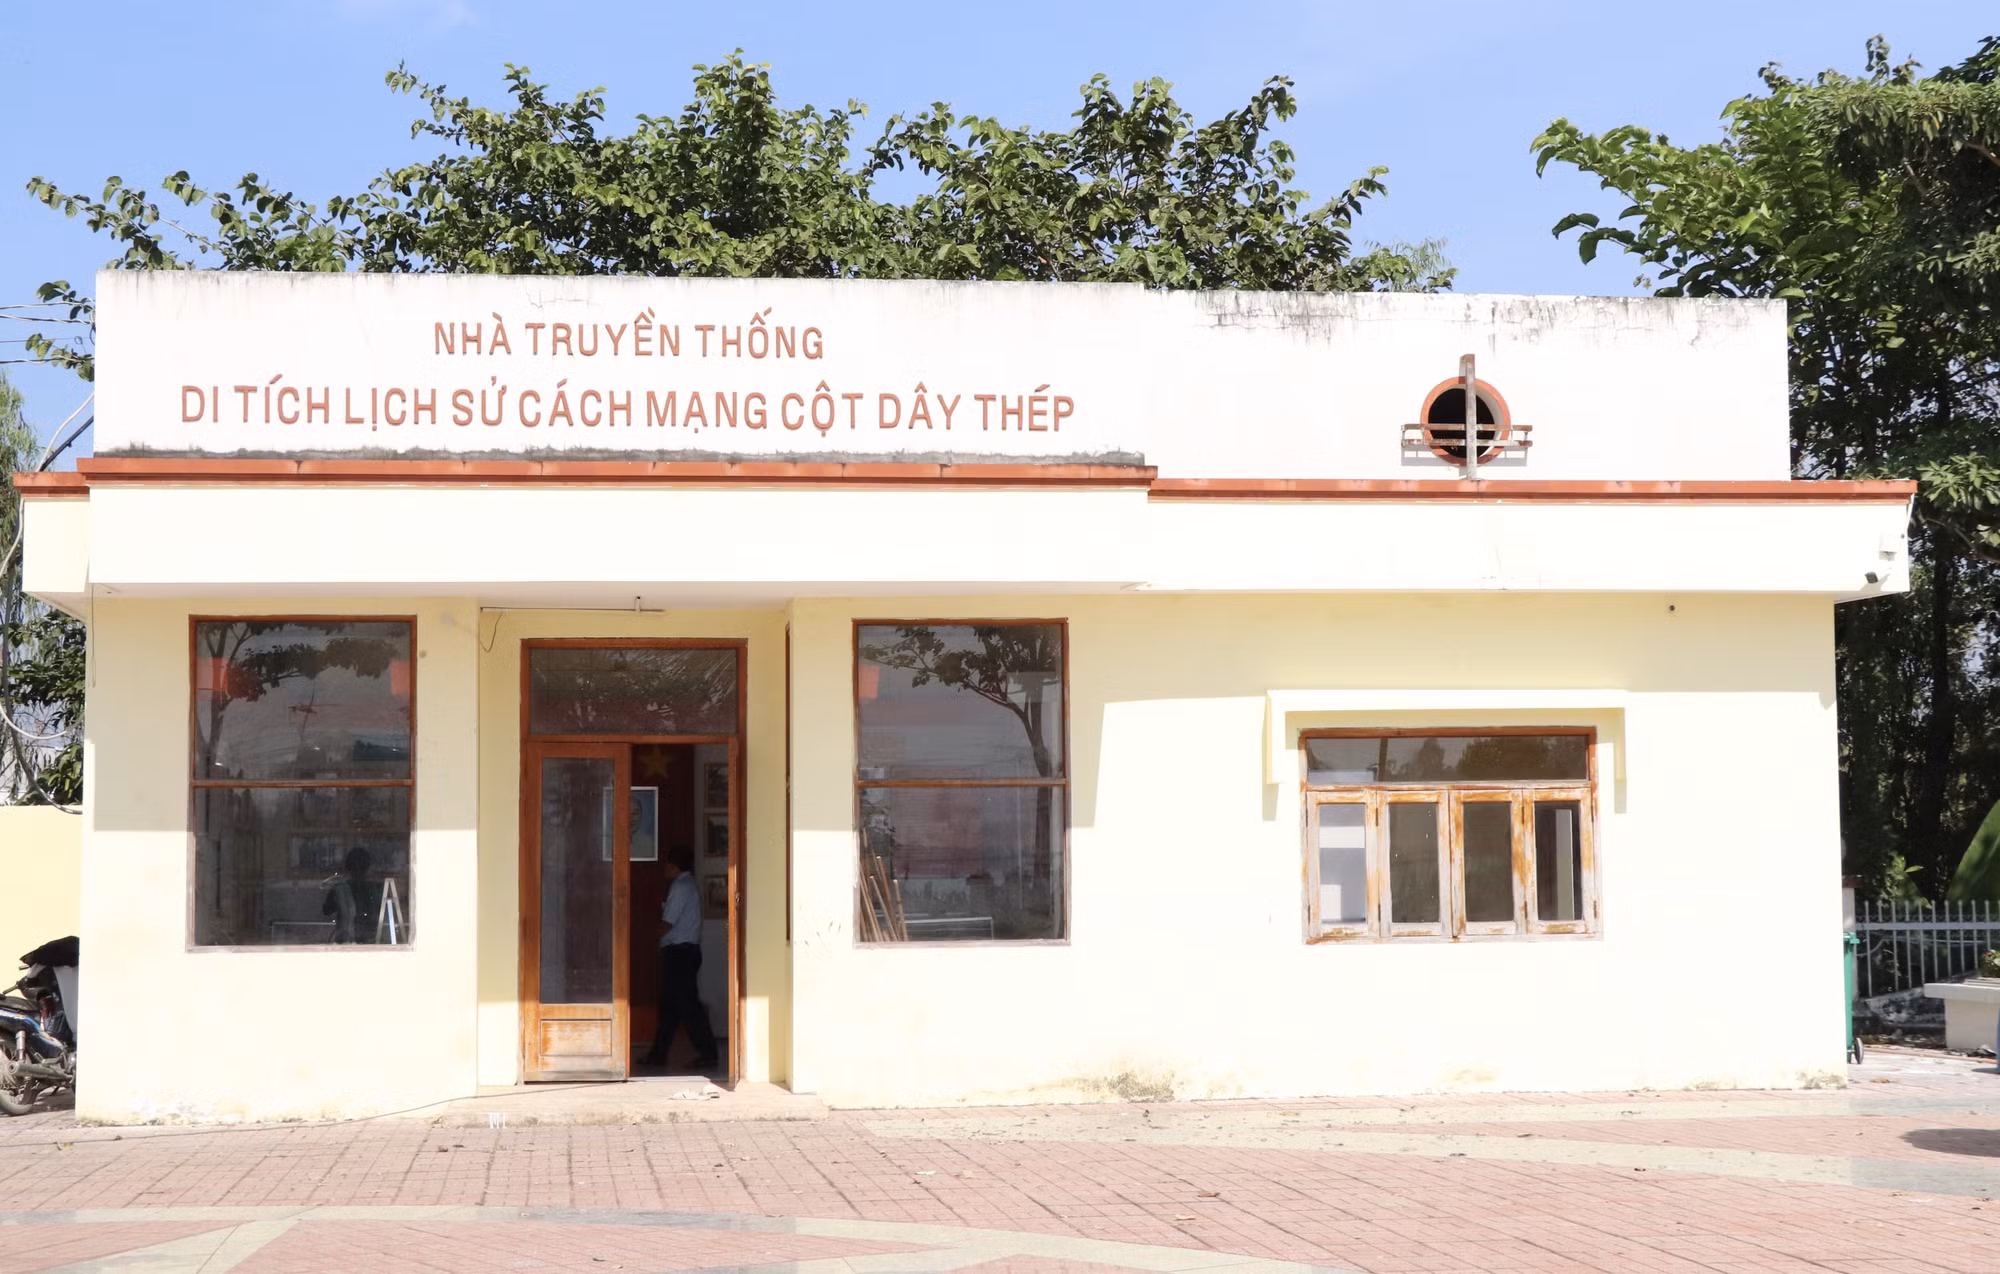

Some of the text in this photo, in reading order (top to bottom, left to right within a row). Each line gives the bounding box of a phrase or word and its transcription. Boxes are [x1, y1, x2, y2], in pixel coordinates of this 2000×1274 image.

[435, 306, 823, 360] NHÀ TRUYỀN THỐNG
[181, 374, 1074, 437] DI TÍCH LỊCH SỬ CÁCH MẠNG CỘT DÂY THÉP
